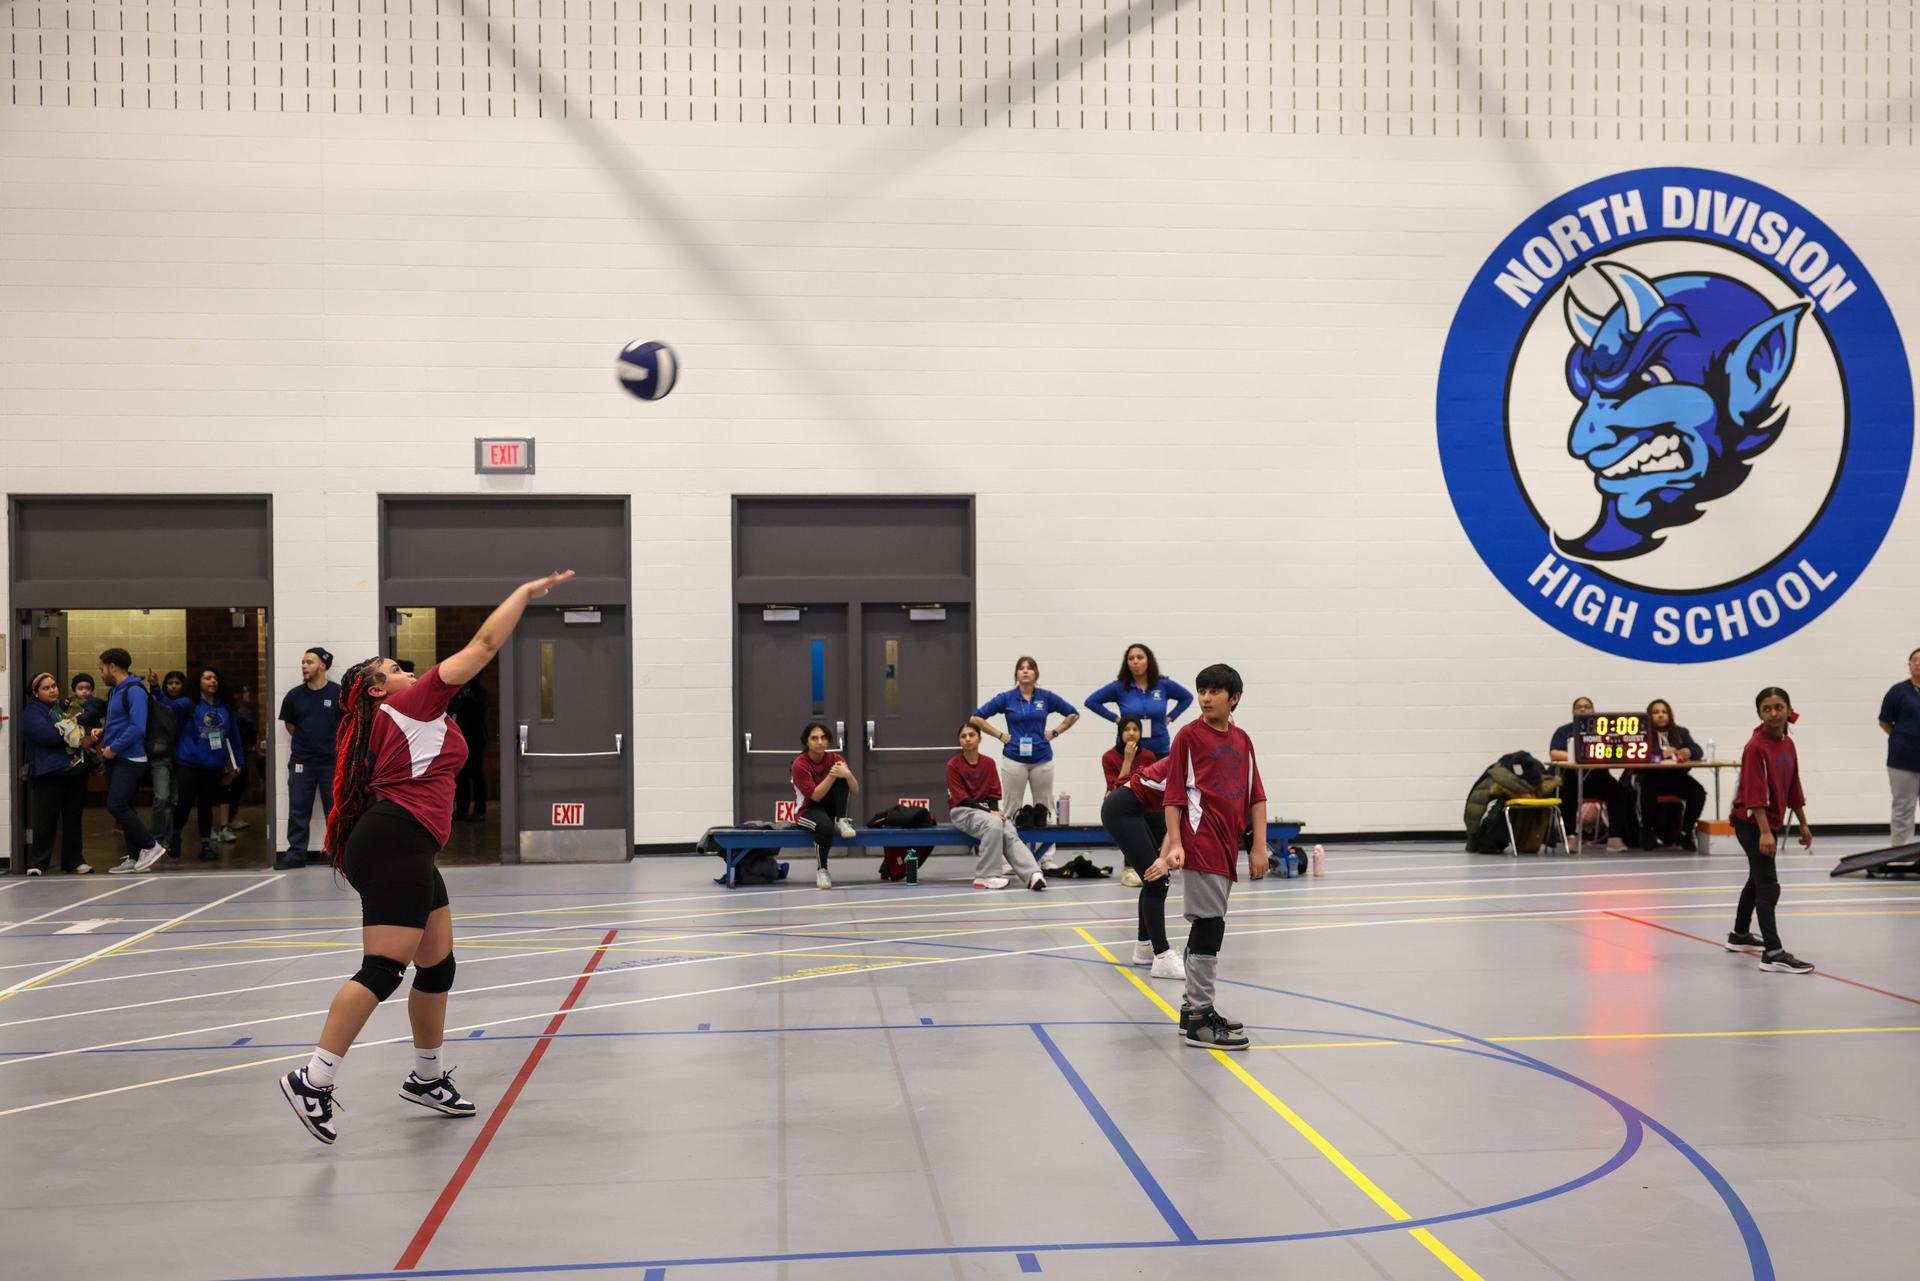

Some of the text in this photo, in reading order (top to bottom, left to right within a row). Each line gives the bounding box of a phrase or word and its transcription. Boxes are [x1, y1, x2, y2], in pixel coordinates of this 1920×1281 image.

[1494, 186, 1857, 313] NORTH DIVISION
[490, 444, 520, 465] EXIT
[1527, 553, 1838, 646] HIGH SCHOOL
[1596, 716, 1639, 735] 0:00
[1589, 742, 1606, 759] 18
[1626, 742, 1648, 759] 22
[554, 804, 582, 824] EXIT
[777, 802, 796, 822] EX
